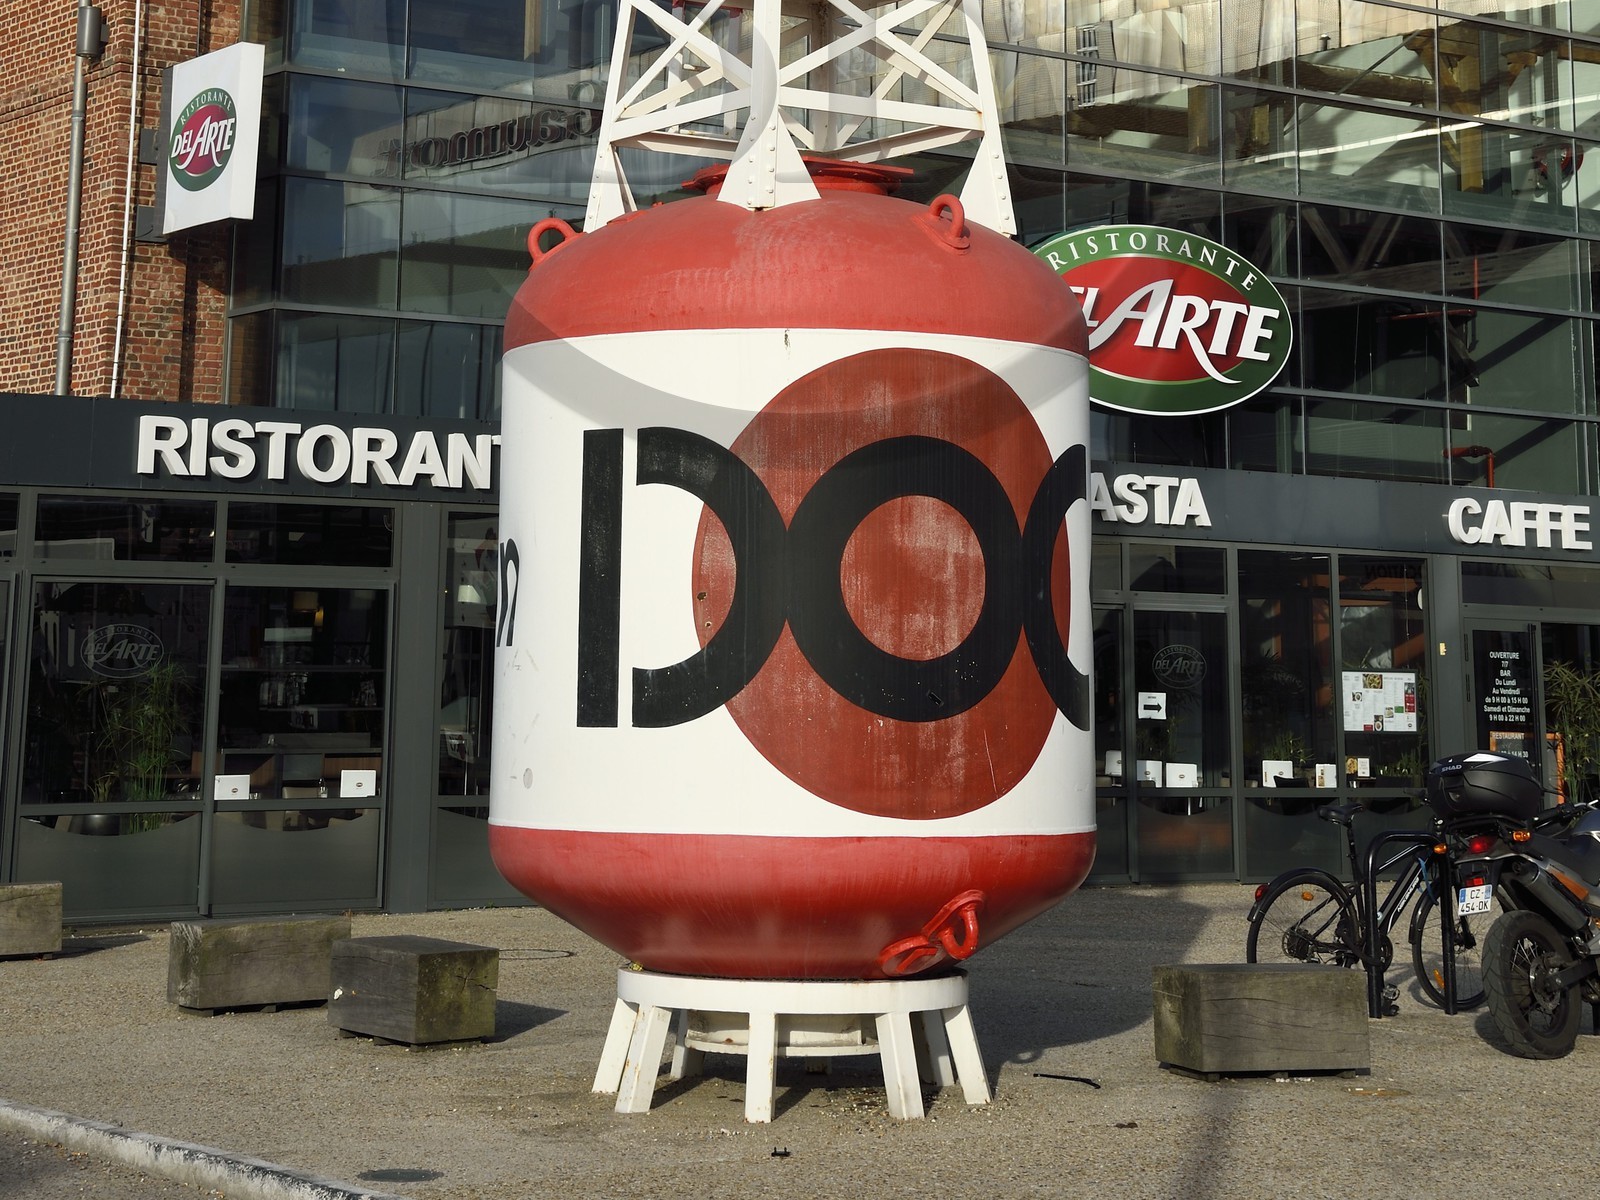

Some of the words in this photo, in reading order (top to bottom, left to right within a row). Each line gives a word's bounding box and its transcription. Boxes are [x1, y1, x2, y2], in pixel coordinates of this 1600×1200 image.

[180, 91, 232, 126] RISTORANTE
[1045, 232, 1258, 292] RISTORANTE
[1089, 278, 1281, 385] ARTE
[137, 414, 501, 490] RISTORAN
[1448, 497, 1593, 550] CAFFE
[1489, 651, 1520, 660] OUVERTURE
[1500, 669, 1511, 677] BAR
[1492, 687, 1499, 695] Au
[1507, 706, 1530, 714] Dimanche
[1492, 732, 1525, 740] RESTAURANT
[1441, 764, 1463, 772] SHAD
[1460, 900, 1489, 913] 454-DK
